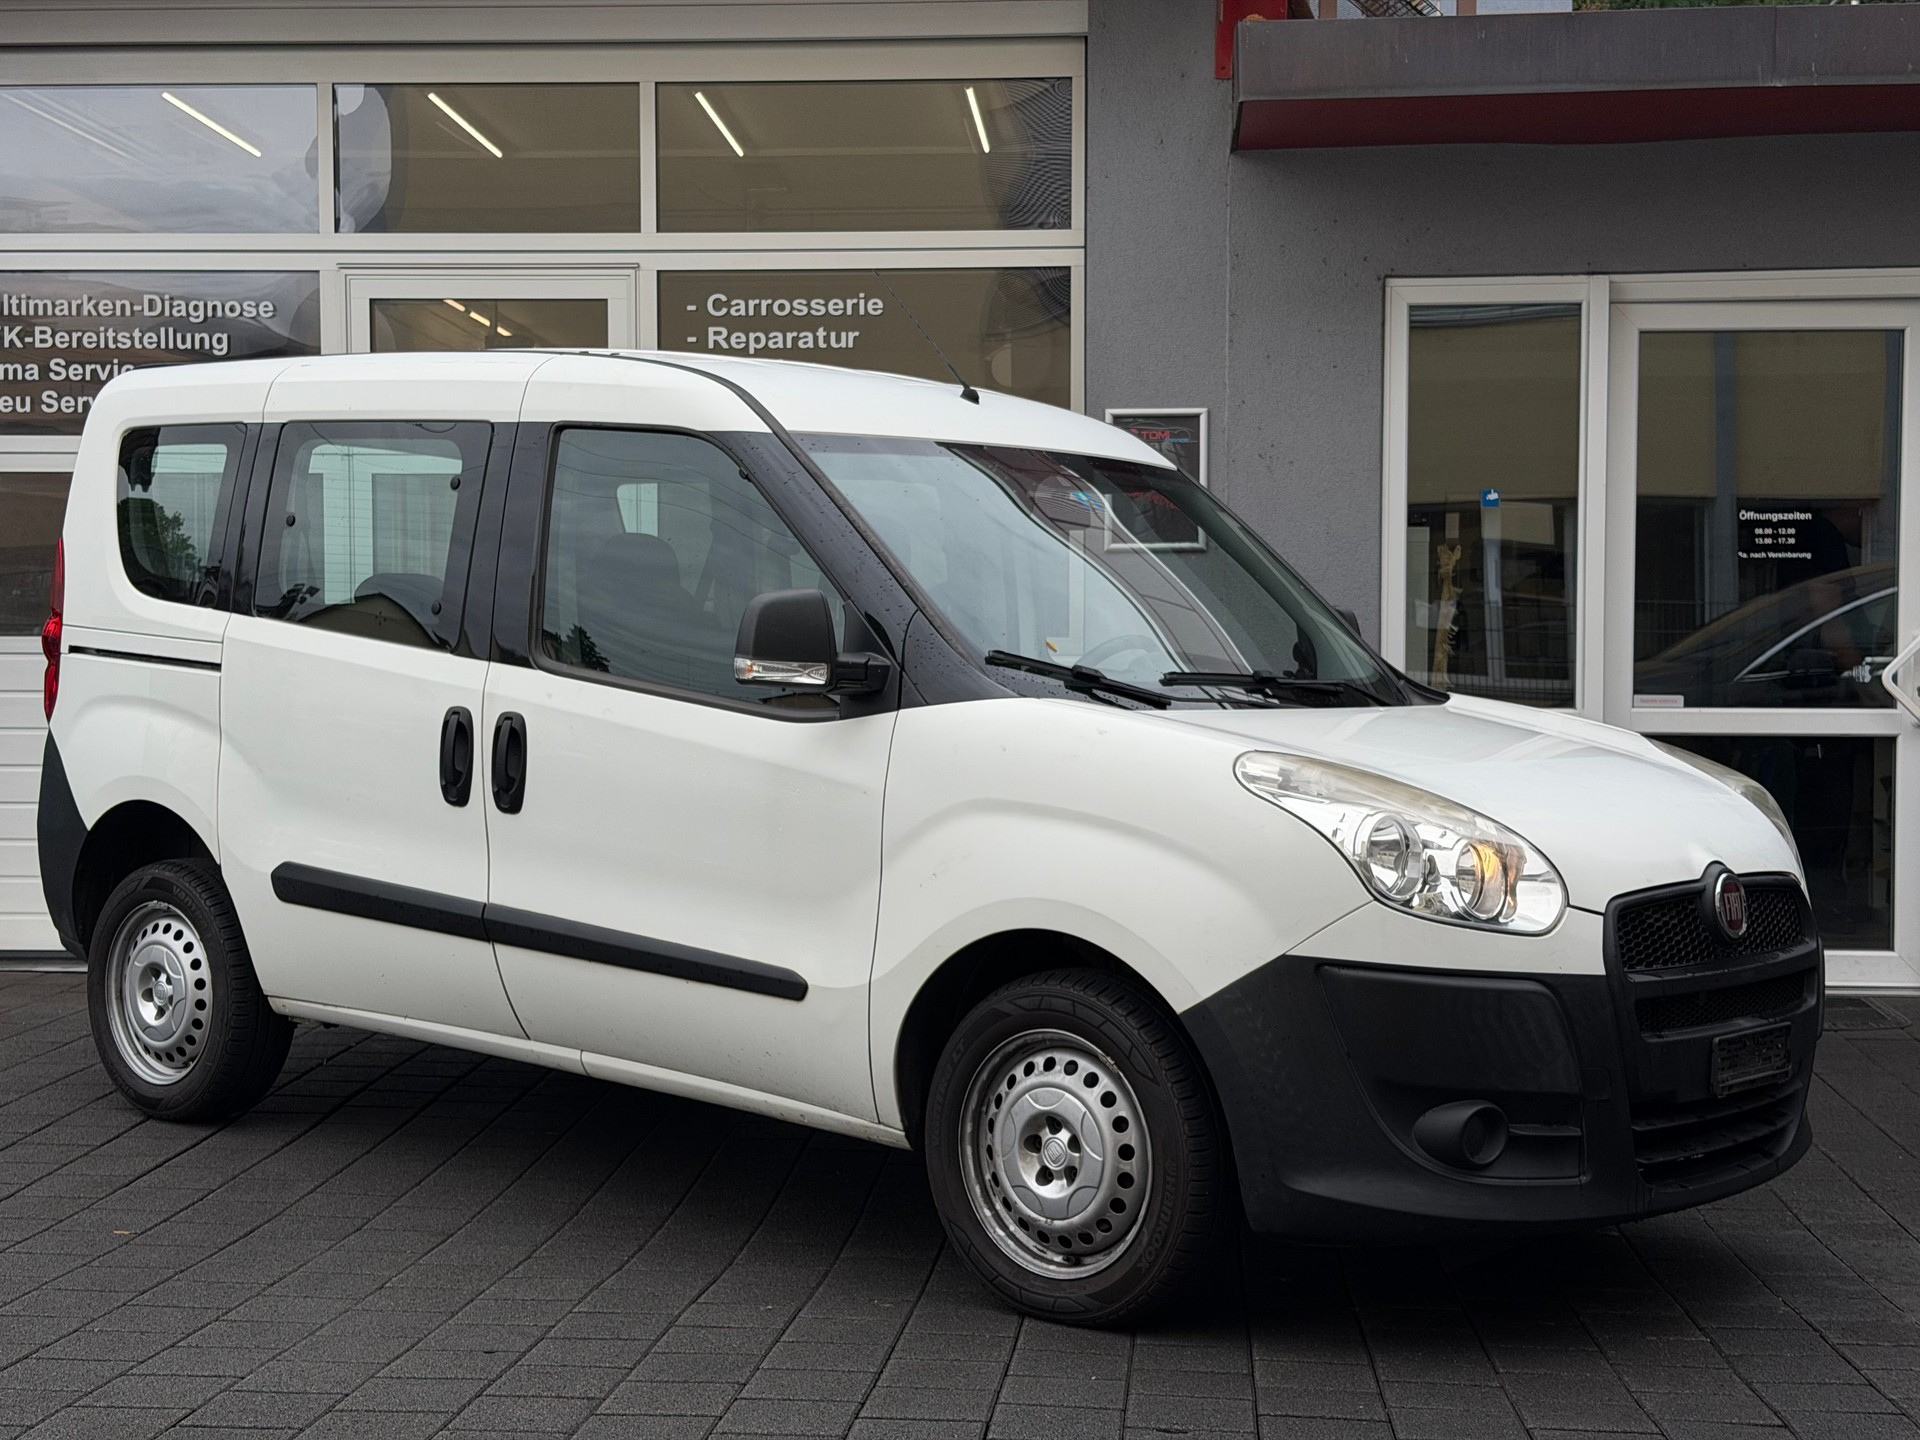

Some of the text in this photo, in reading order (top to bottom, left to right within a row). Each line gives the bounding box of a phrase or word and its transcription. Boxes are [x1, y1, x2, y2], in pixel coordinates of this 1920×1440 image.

[3, 294, 275, 323] ltimarken-Diagnose
[706, 293, 884, 317] Carrosserie
[0, 325, 230, 356] K-Bereitstellung
[707, 326, 860, 354] Reparatur
[1739, 509, 1812, 522] Öffnungszeiten
[1754, 527, 1773, 535] 08.00
[1749, 551, 1767, 559] nach
[1767, 551, 1812, 560] Vereinbarung
[1723, 892, 1742, 920] FIAT
